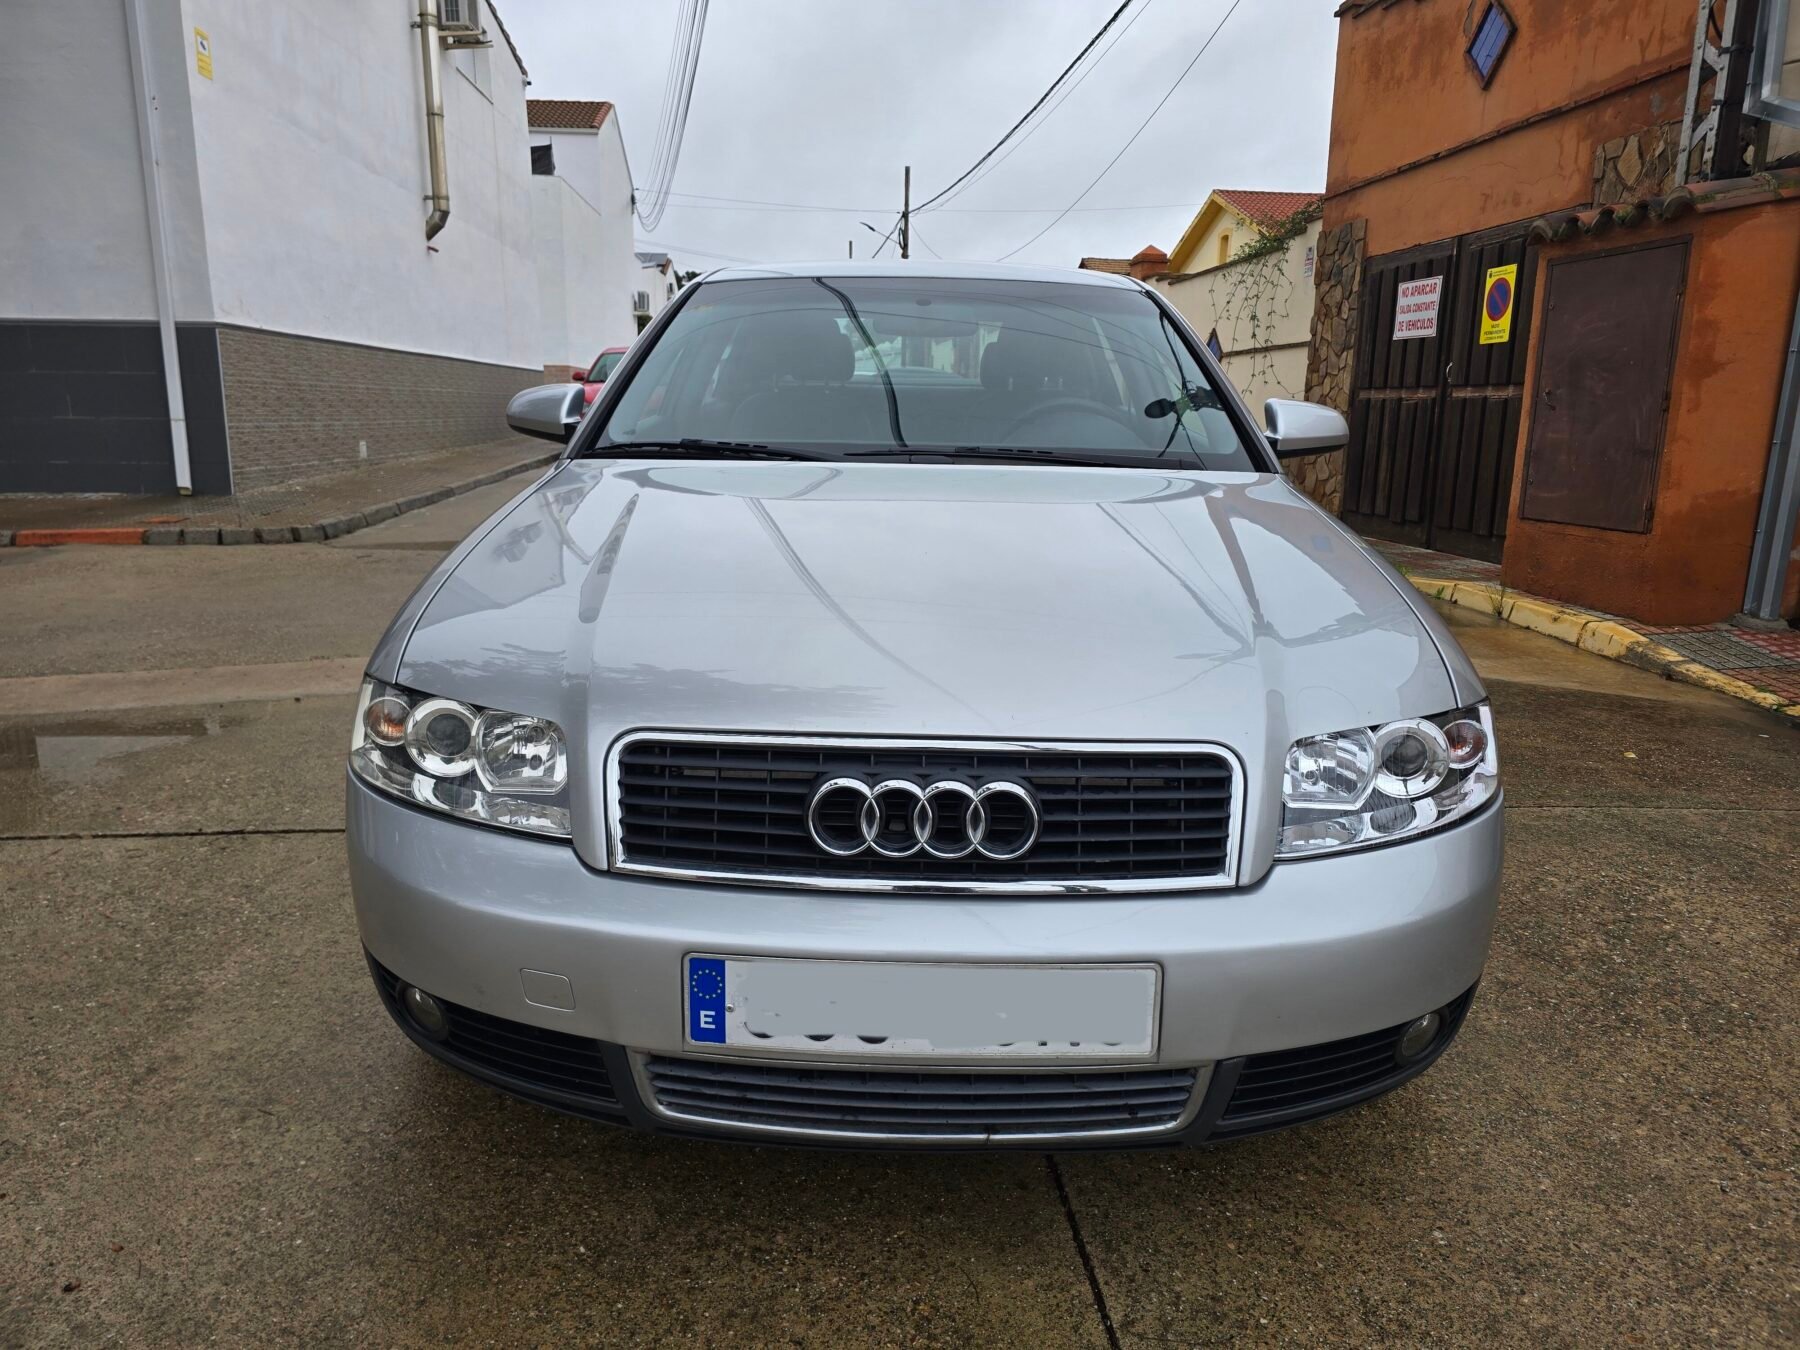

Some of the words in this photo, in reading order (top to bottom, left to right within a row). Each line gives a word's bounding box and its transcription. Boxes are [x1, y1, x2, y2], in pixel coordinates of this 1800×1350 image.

[1402, 287, 1410, 298] NO
[1410, 283, 1437, 297] APARCAR
[1400, 303, 1412, 315] SALIDA
[1412, 301, 1436, 312] CONSTANTE
[1397, 320, 1404, 332] DE
[1405, 318, 1433, 331] VEHICULOS
[700, 1010, 716, 1029] E
